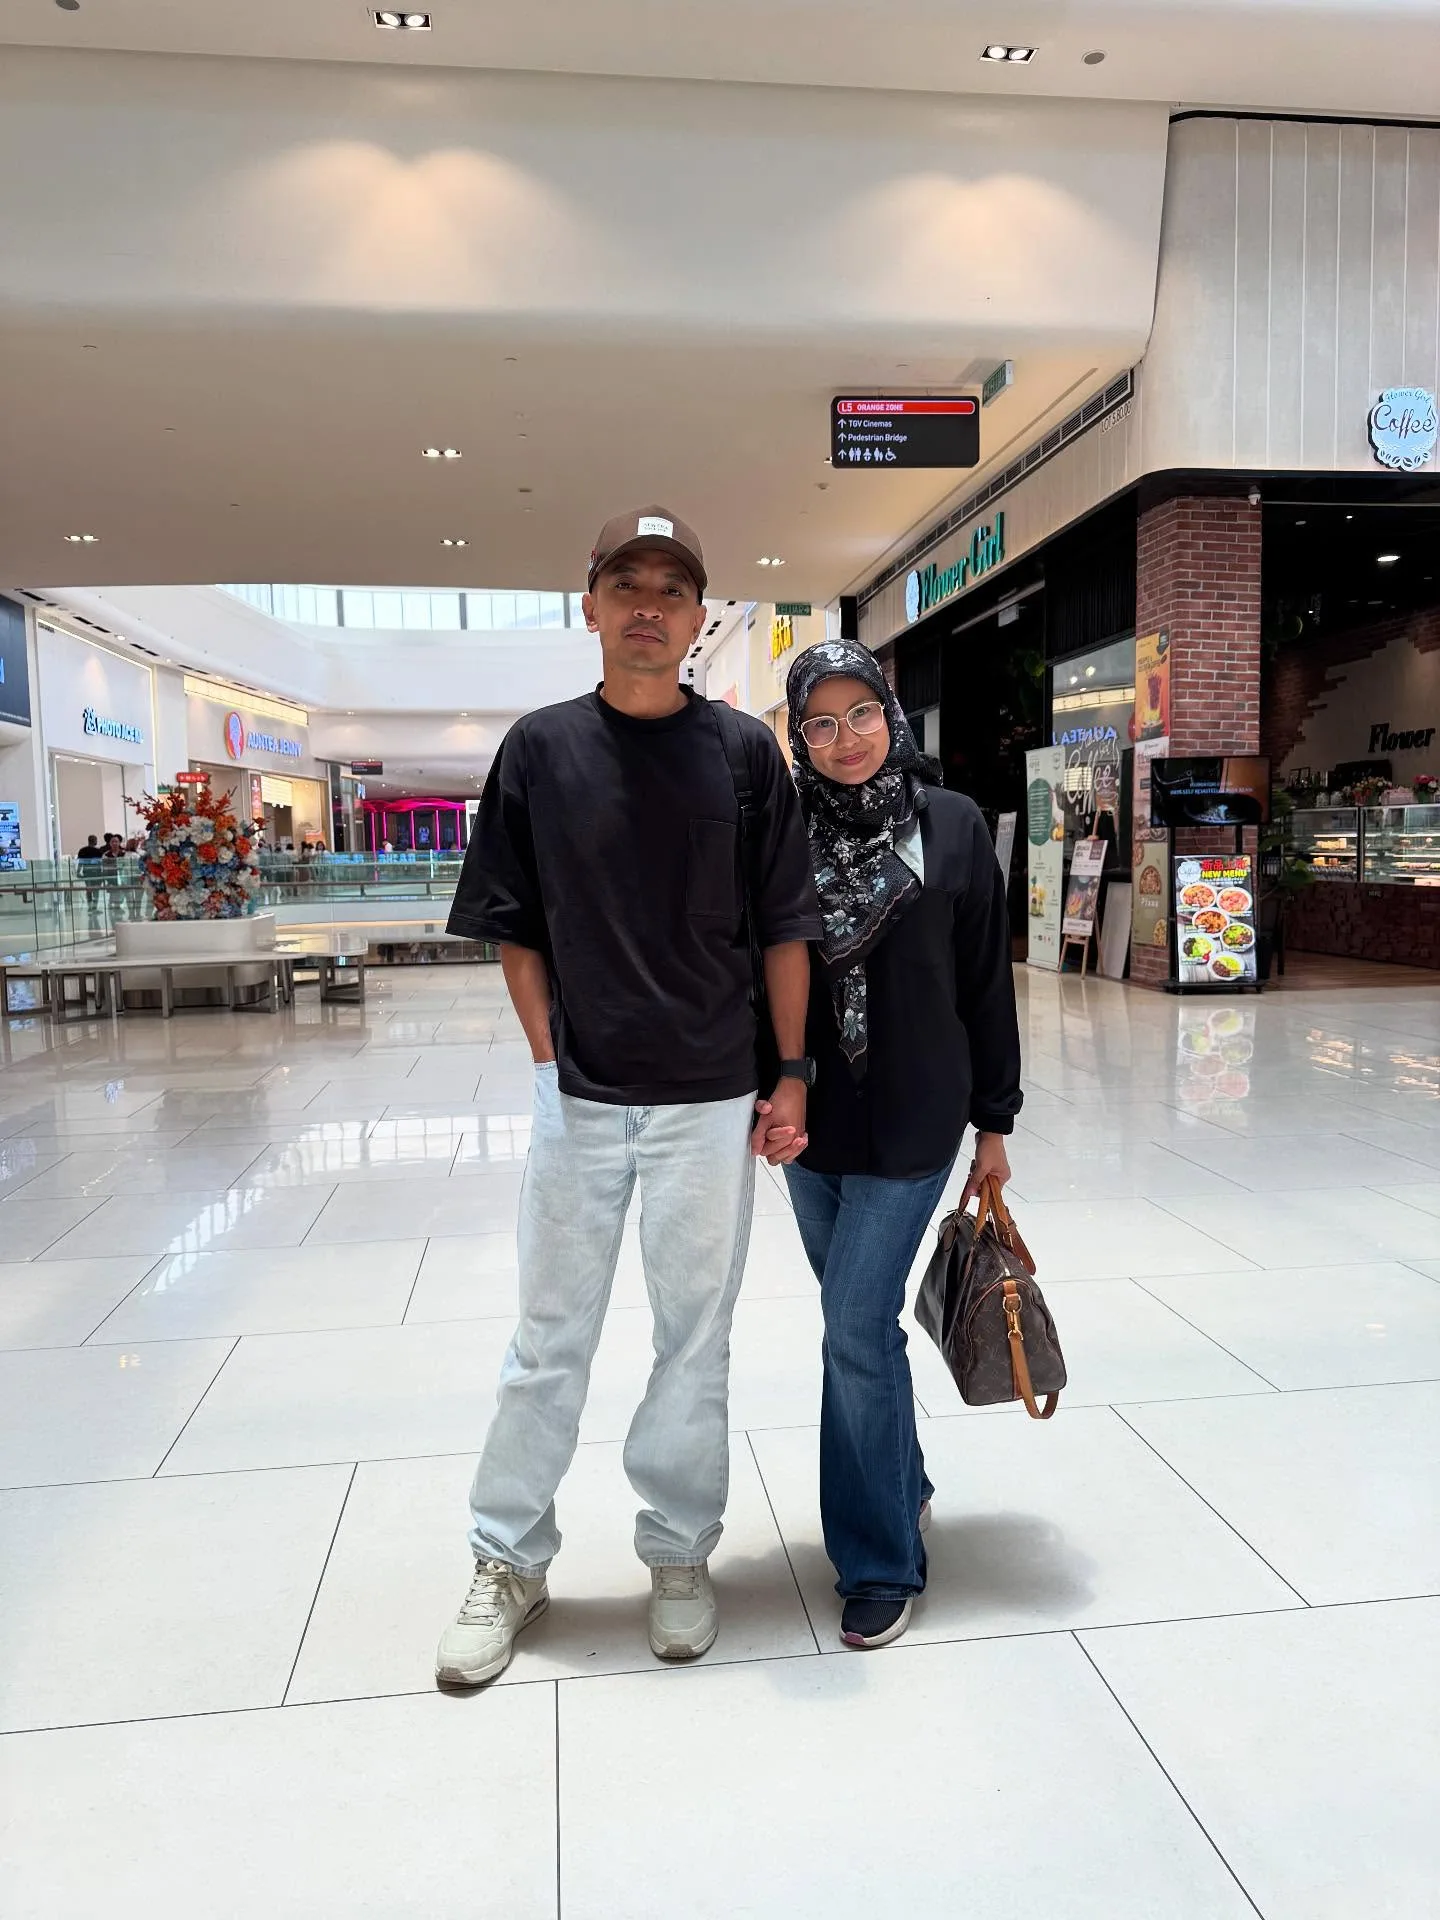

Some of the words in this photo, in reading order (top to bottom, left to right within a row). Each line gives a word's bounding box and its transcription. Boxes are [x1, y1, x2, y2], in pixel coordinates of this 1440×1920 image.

[841, 403, 852, 412] L5
[857, 403, 884, 411] ORANGE
[885, 403, 904, 411] ZONE
[848, 420, 862, 428] TGV
[863, 420, 892, 428] Cinemas
[1373, 404, 1435, 439] Coffee
[848, 433, 884, 442] Pedestrian
[885, 433, 907, 443] Bridge
[920, 562, 969, 611] Flower
[970, 511, 1005, 578] Girl
[97, 716, 121, 739] PHOTO
[1367, 721, 1436, 753] Flower
[1202, 870, 1221, 878] NEW
[1223, 869, 1247, 877] MENU
